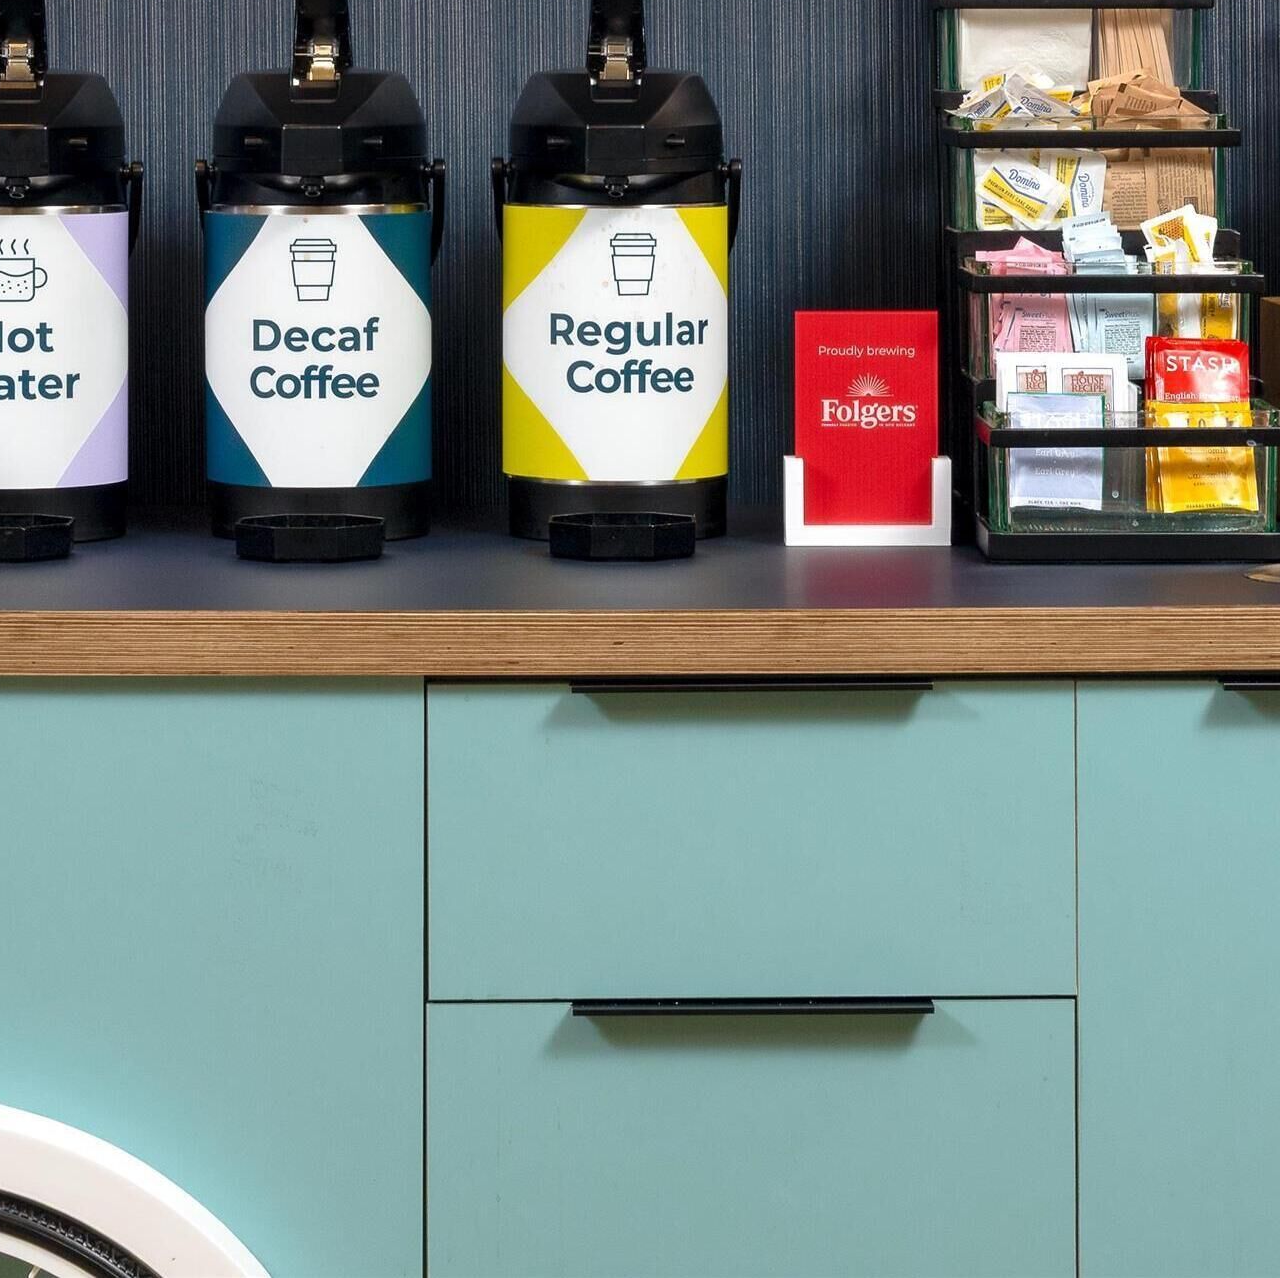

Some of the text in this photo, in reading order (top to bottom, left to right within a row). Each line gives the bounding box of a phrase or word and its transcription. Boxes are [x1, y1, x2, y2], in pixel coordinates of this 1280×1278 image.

[1021, 97, 1052, 114] Domino
[1009, 168, 1041, 191] Domino
[1078, 173, 1090, 208] Domino
[252, 317, 380, 352] Decaf
[550, 312, 709, 355] Regular
[818, 345, 916, 359] Proudly brewing
[1166, 355, 1240, 373] STASH
[250, 364, 380, 399] Coffee
[566, 359, 695, 393] Coffee
[1025, 373, 1047, 382] HOU
[1071, 375, 1104, 385] HOUSE
[1026, 382, 1045, 390] REC
[1071, 384, 1105, 393] RECIPE
[1164, 392, 1196, 402] English
[821, 399, 917, 430] Folgers
